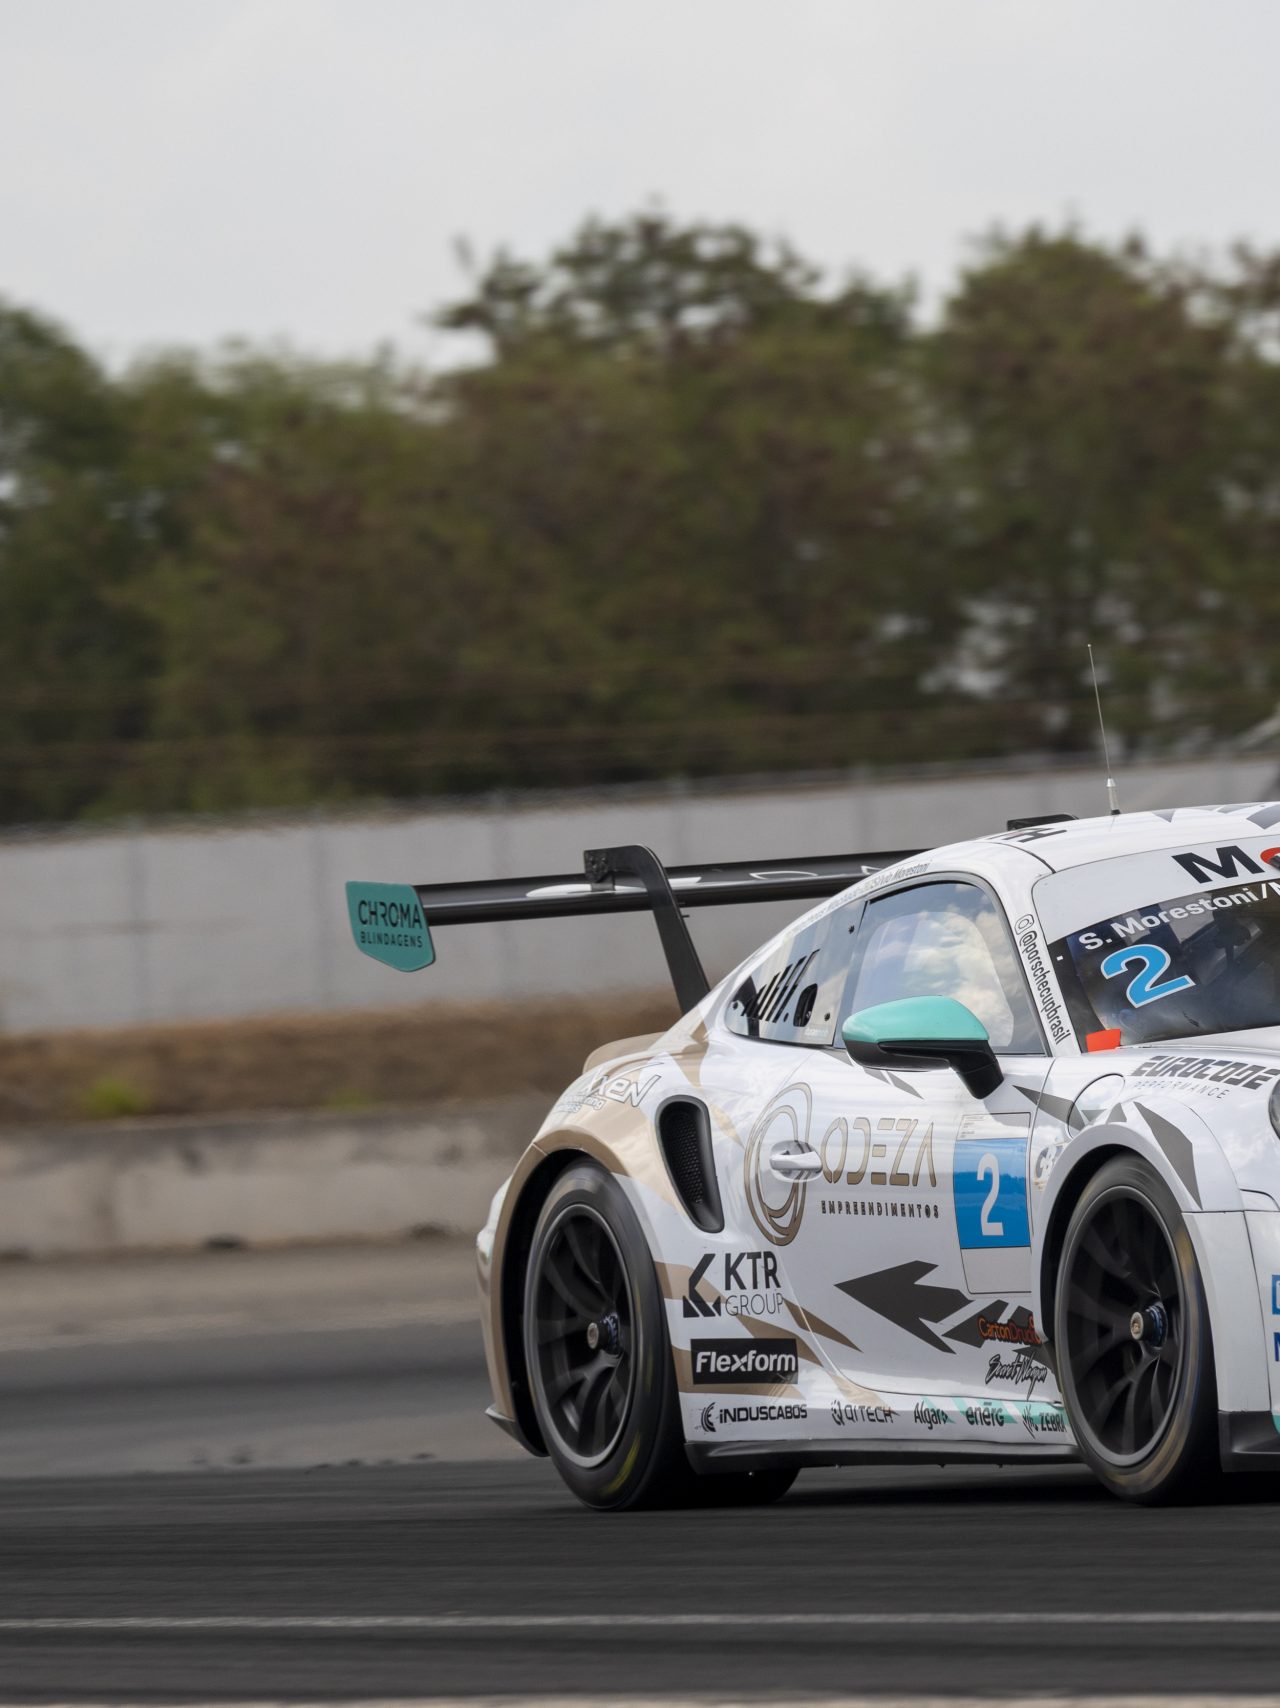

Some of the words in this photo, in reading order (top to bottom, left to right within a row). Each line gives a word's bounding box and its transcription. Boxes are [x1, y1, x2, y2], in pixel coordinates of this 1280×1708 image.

[358, 900, 423, 929] CHROMA
[360, 931, 423, 948] BLINDAGENS
[1078, 930, 1113, 950] S.
[1019, 930, 1072, 1045] @porschecupbrasil
[1100, 943, 1196, 1009] 2
[821, 1116, 937, 1188] ODEZA
[976, 1152, 1004, 1236] 2
[821, 1200, 939, 1219] EMPREENDIMENTOS
[724, 1250, 782, 1291] KTR
[725, 1292, 785, 1317] GROUP
[695, 1350, 797, 1373] Flexform
[913, 1400, 942, 1430] Algar
[1039, 1411, 1067, 1432] ZEBRA
